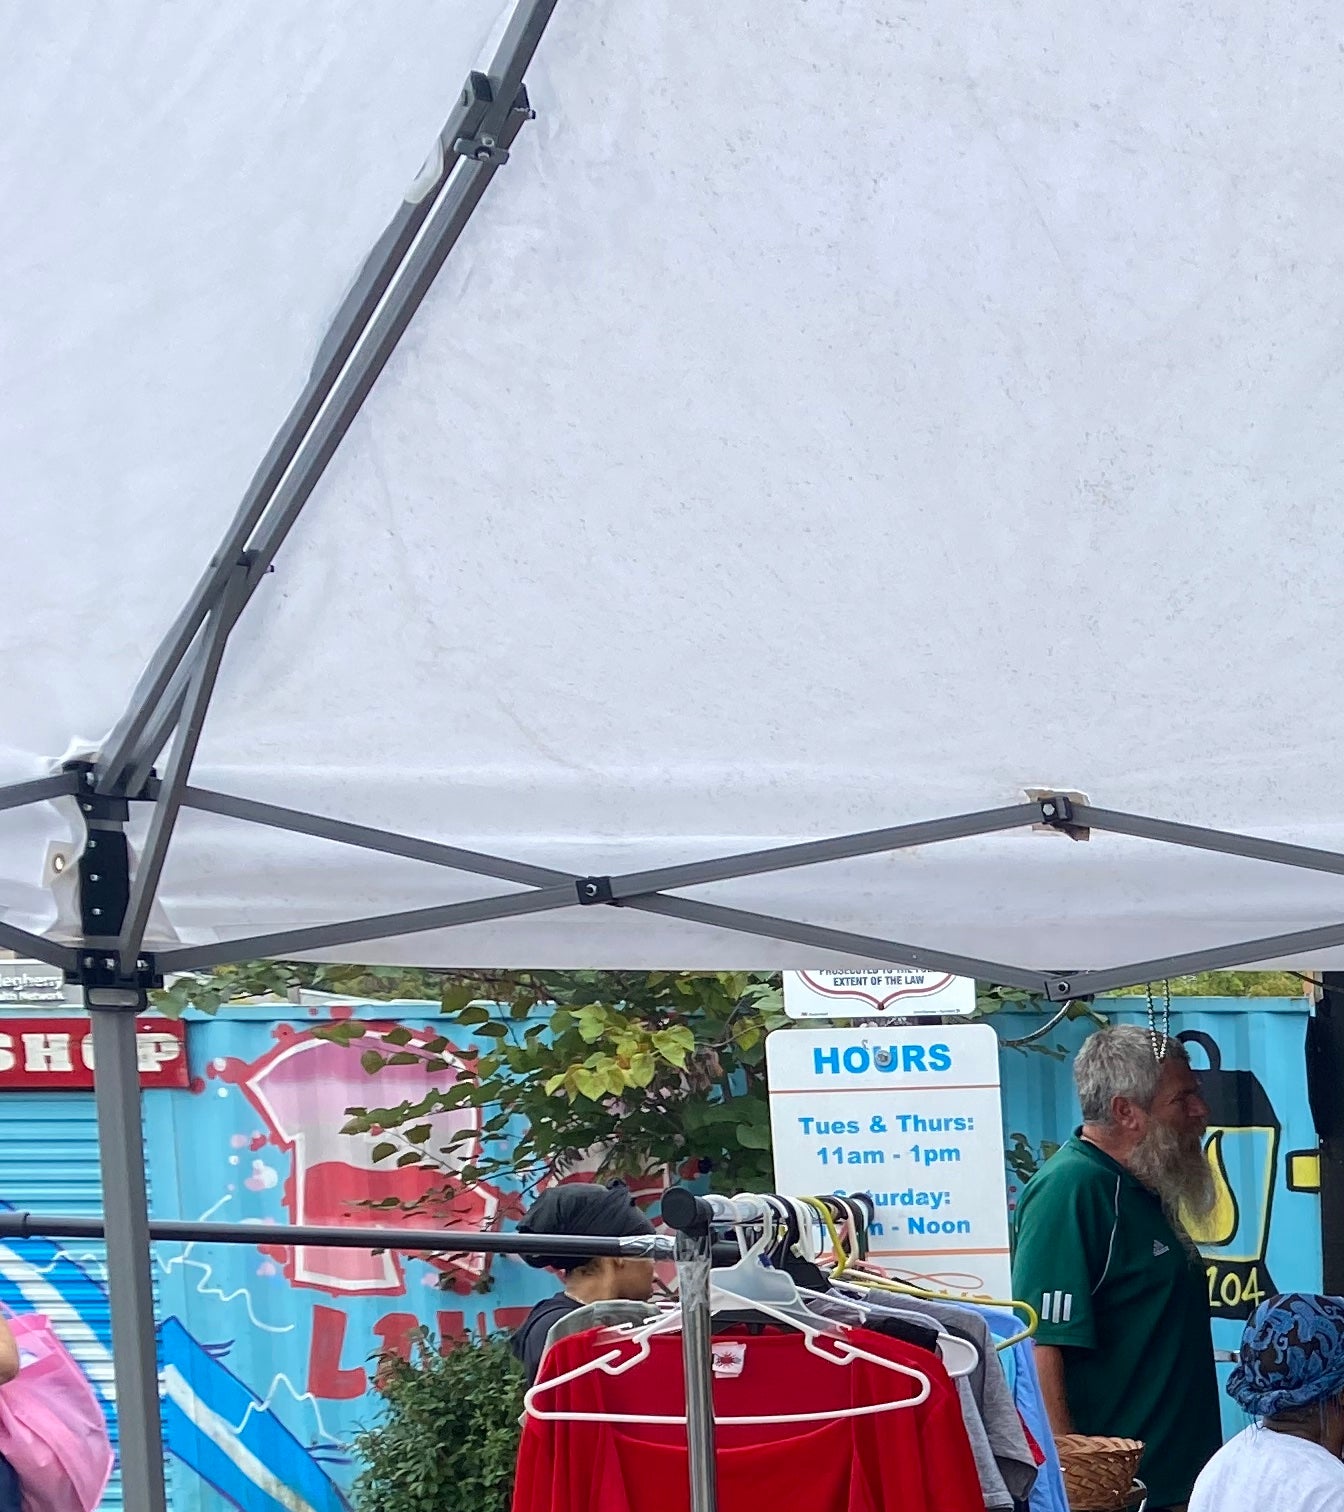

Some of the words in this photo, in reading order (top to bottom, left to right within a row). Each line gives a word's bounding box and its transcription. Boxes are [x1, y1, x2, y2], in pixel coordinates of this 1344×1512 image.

[833, 977, 868, 987] EXTENT
[871, 976, 882, 986] OF
[885, 976, 902, 985] THE
[905, 975, 925, 985] LAW
[813, 1043, 953, 1075] HOURS
[798, 1117, 860, 1135] Tues
[869, 1115, 887, 1133] &
[895, 1114, 974, 1132] Thurs:
[817, 1146, 885, 1165] 11am
[909, 1144, 961, 1167] 1pm
[907, 1217, 971, 1235] Noon
[1206, 1265, 1266, 1308] 104
